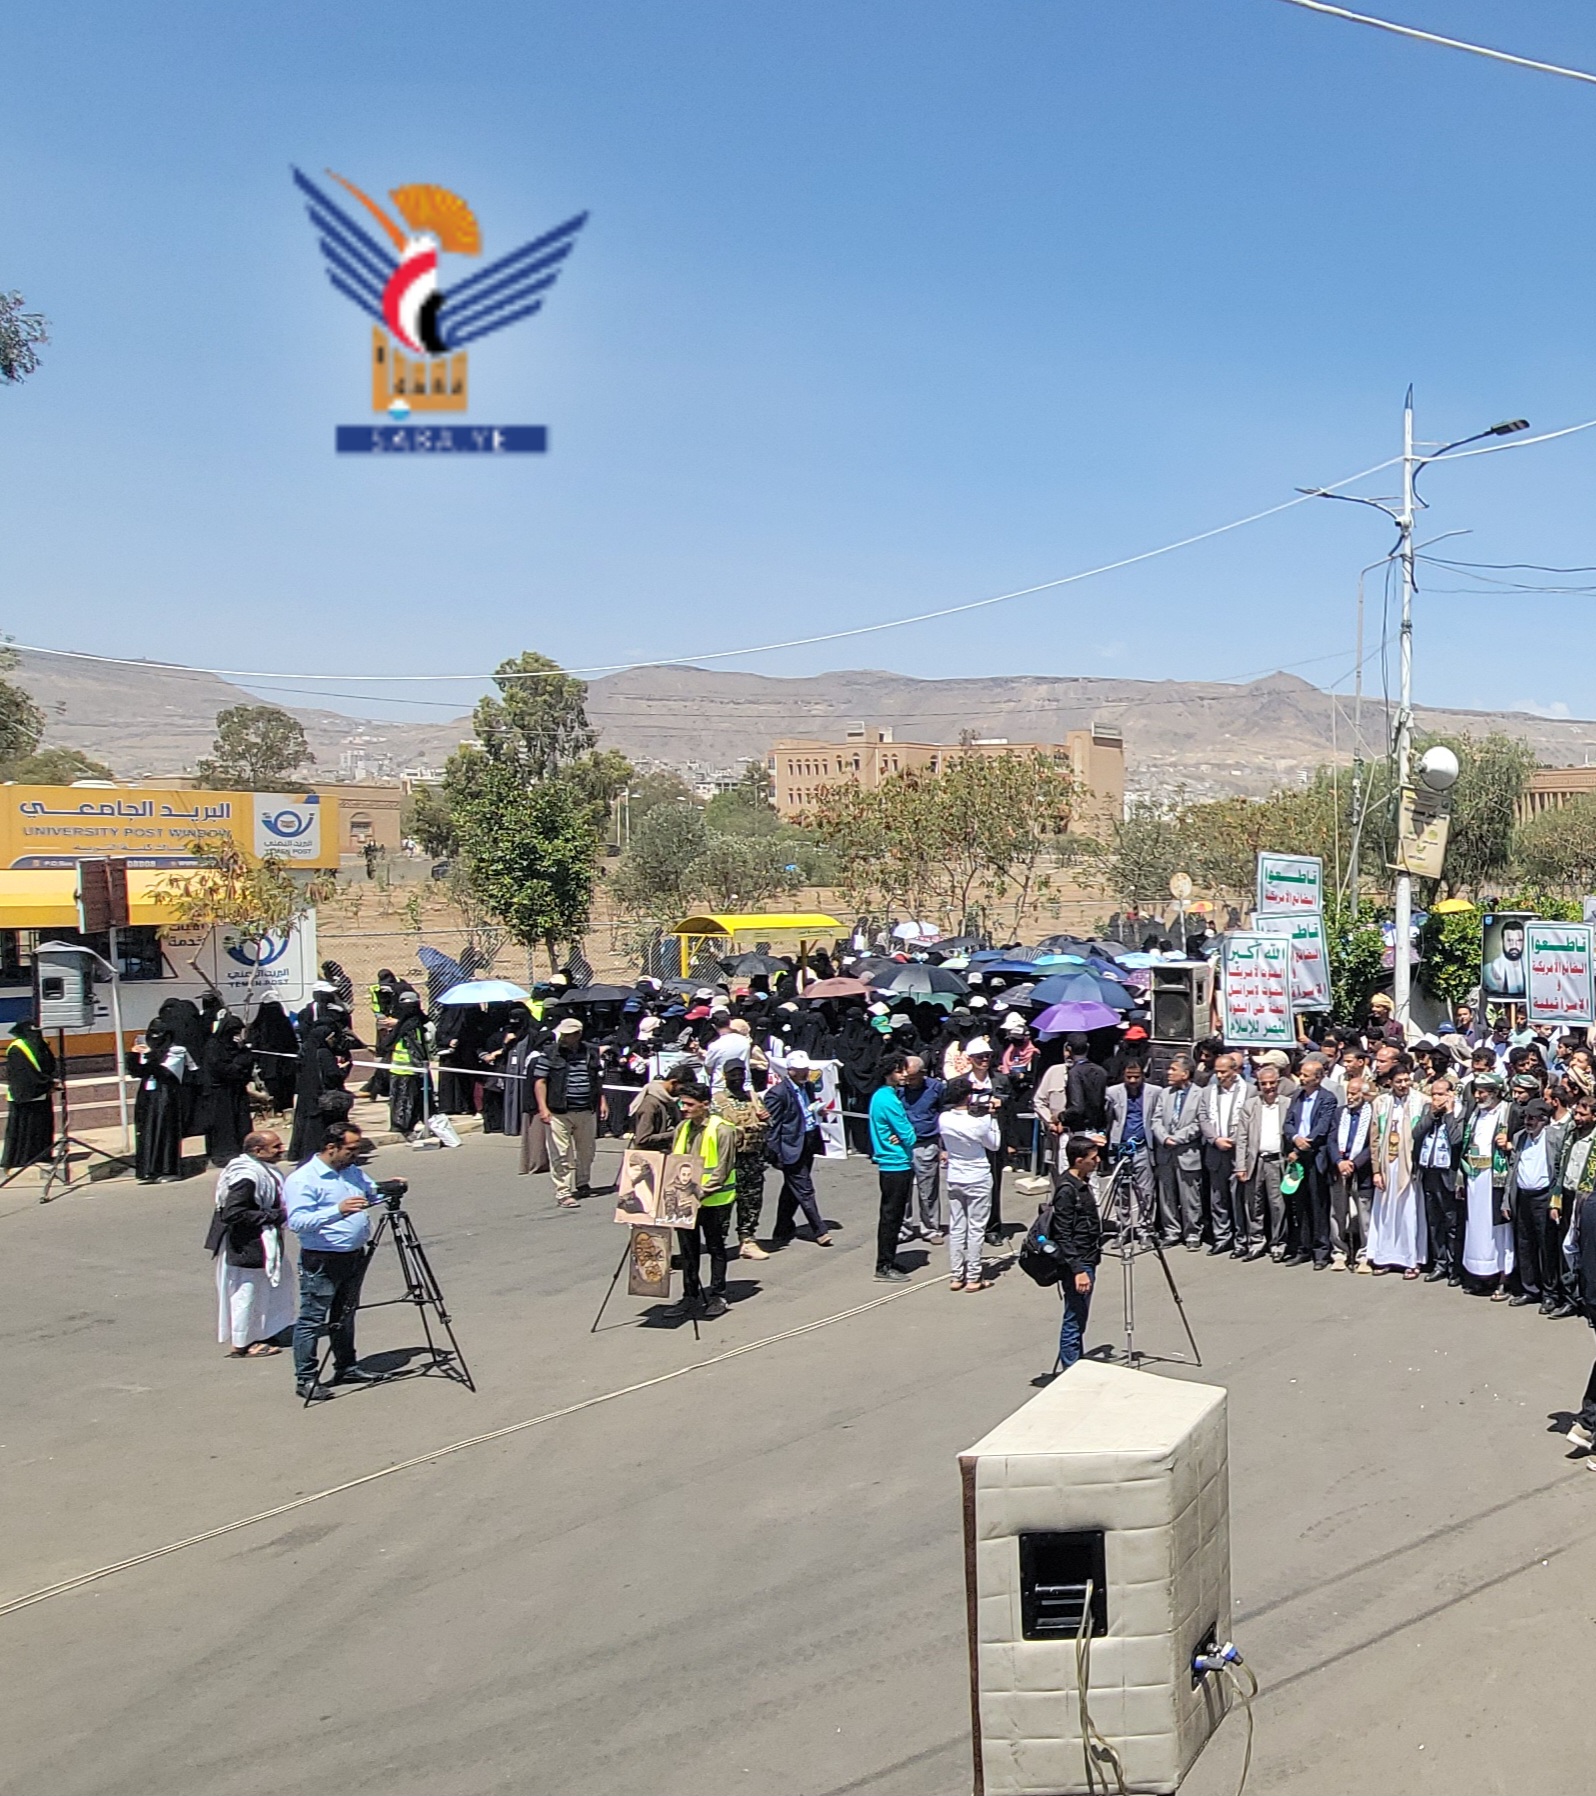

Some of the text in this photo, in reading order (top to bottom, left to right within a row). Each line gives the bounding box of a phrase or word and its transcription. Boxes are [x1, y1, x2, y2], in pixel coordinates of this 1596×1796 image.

[19, 799, 231, 822] البريد الجامعي
[23, 827, 232, 839] UNIVERSITY POST WINDOW
[1265, 866, 1317, 885] قاطعوا
[1227, 940, 1285, 964] الله أكبر
[1531, 935, 1586, 954] قاطعوا
[263, 978, 290, 987] POST
[1262, 1017, 1289, 1037] النصر
